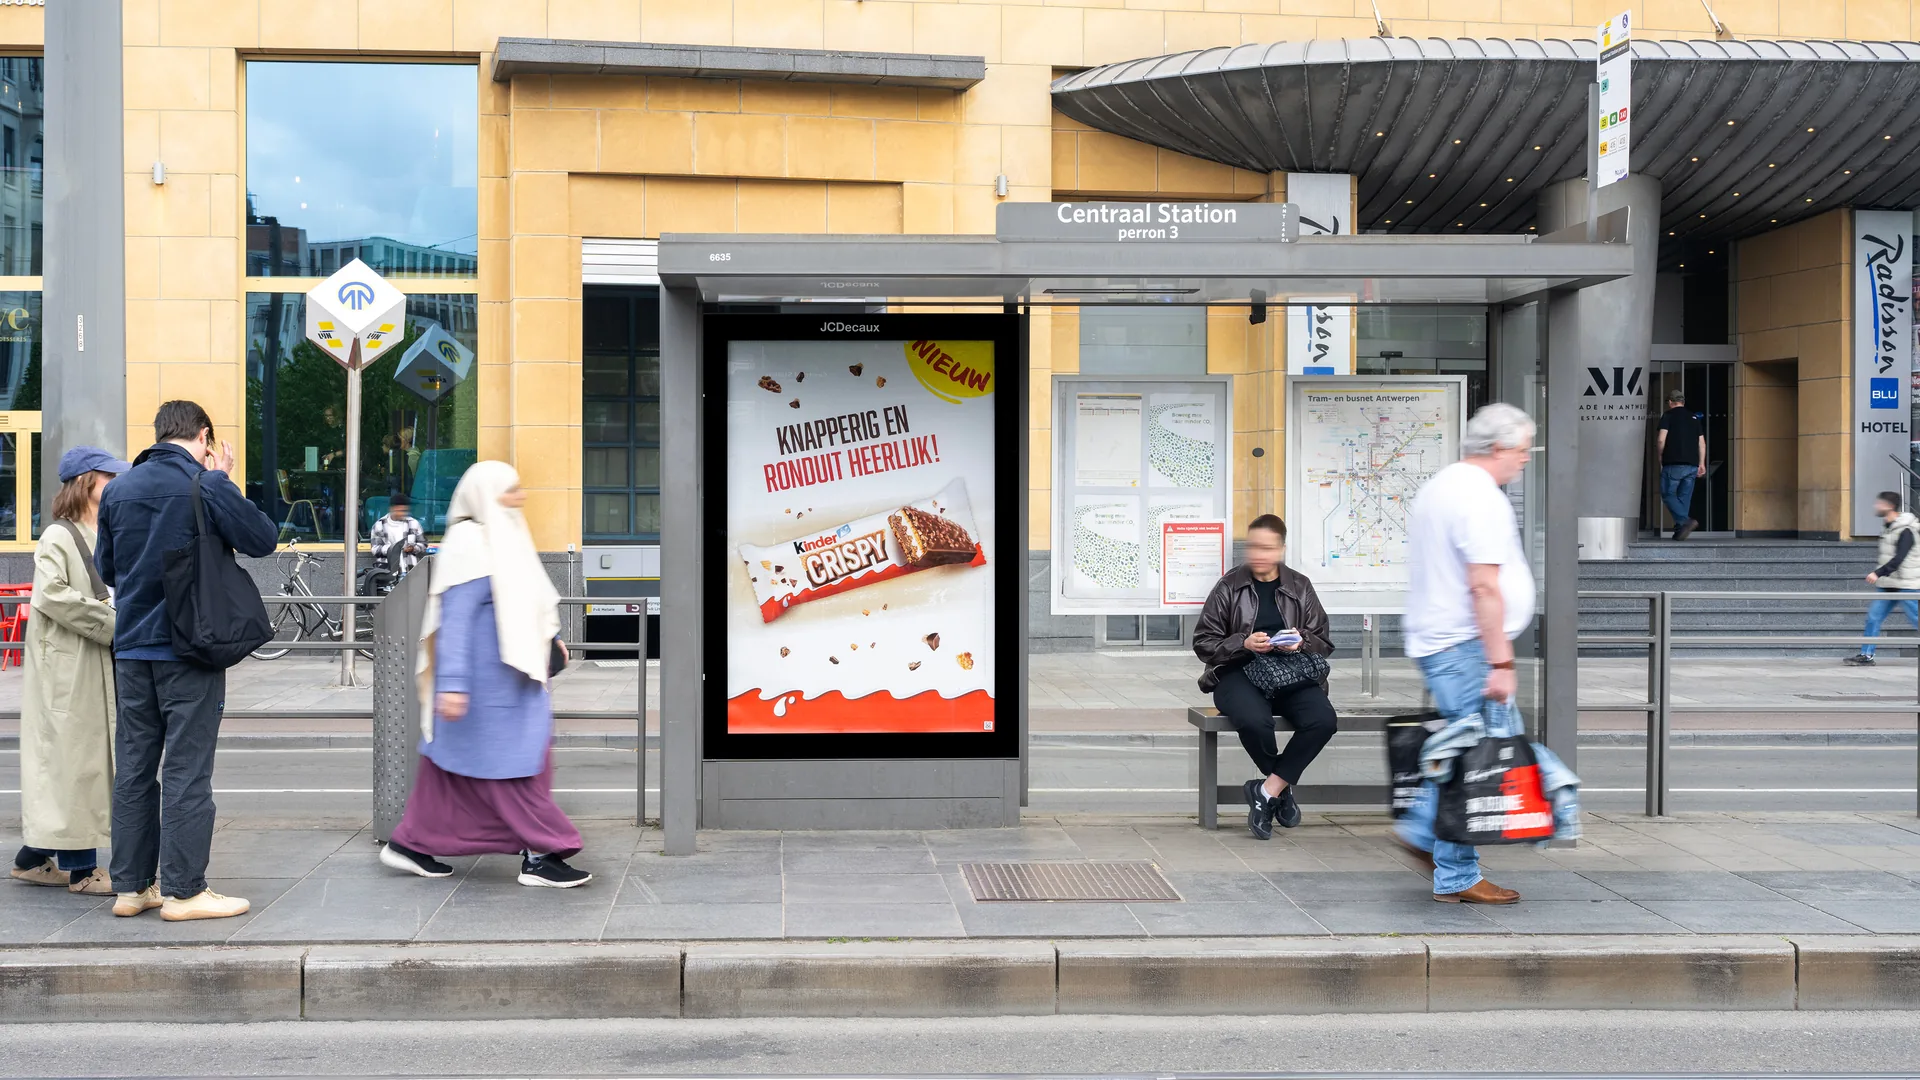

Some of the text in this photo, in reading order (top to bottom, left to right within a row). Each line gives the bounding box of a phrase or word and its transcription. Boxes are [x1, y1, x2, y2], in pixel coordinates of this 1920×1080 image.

[1057, 203, 1236, 223] Centraal Station
[1118, 226, 1179, 242] perron 3
[710, 253, 731, 261] 6635
[1861, 234, 1909, 374] Radisson
[820, 322, 880, 332] JCDecaux
[912, 340, 990, 392] NIEUW
[1376, 395, 1420, 403] Antwerpen
[1872, 390, 1897, 399] BLU
[776, 405, 910, 456] KNAPPERIG EN
[1862, 422, 1908, 433] HOTEL
[764, 434, 940, 493] RONDUIT HEERLIJK!
[806, 532, 888, 586] CRISPY
